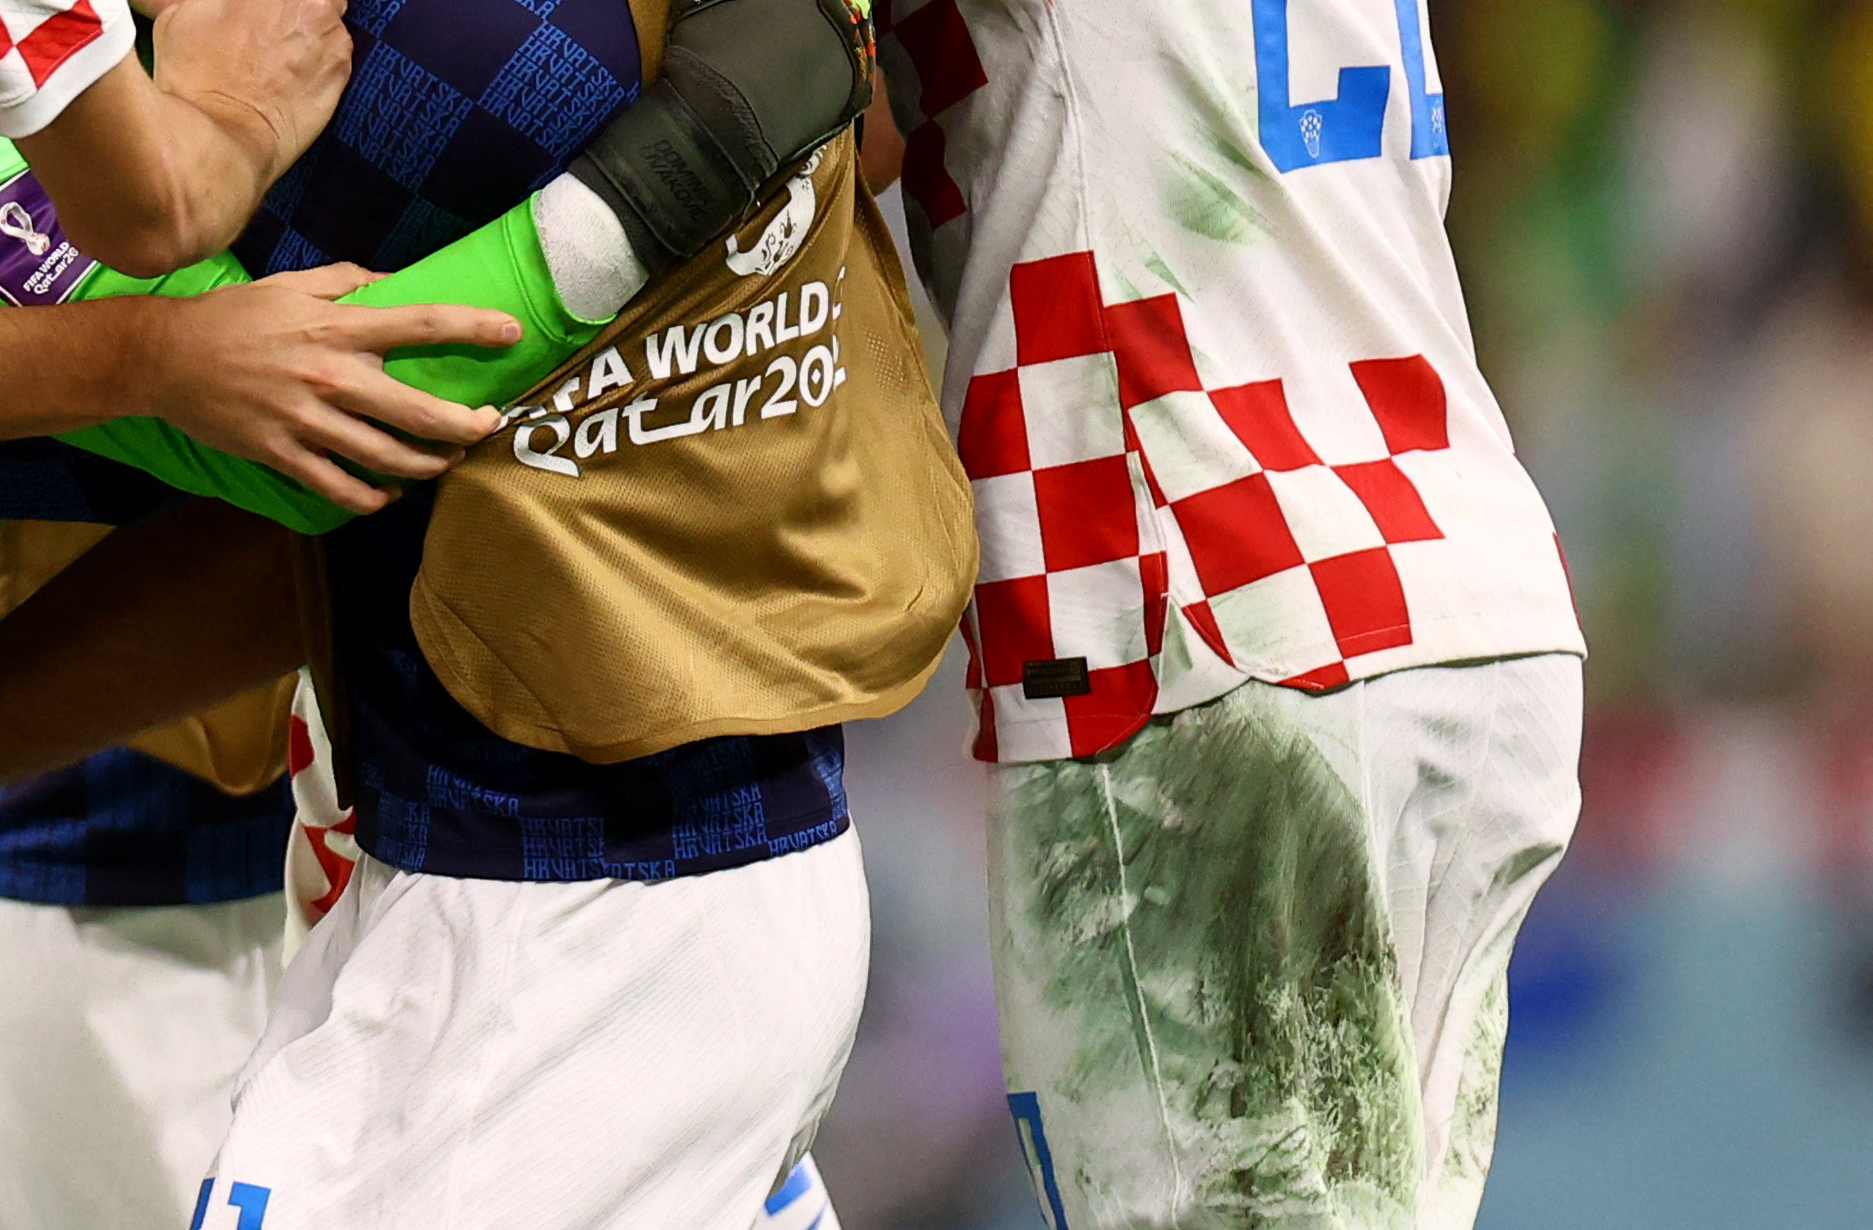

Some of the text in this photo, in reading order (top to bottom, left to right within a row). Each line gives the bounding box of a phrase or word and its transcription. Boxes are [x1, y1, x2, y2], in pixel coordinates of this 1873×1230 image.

[360, 58, 460, 138] HRVATSKA
[369, 40, 474, 119] HRVATSKA
[503, 51, 599, 133] HRVATSKA
[518, 35, 611, 122] HRVATSKA
[532, 21, 625, 107] HRVATSKA
[23, 241, 69, 292] FIFA WORLD
[34, 246, 79, 294] Qatar20
[645, 281, 830, 380] WORLD
[513, 335, 846, 478] Qatar20
[523, 857, 605, 879] HRVATS
[605, 860, 675, 880] ATSKA
